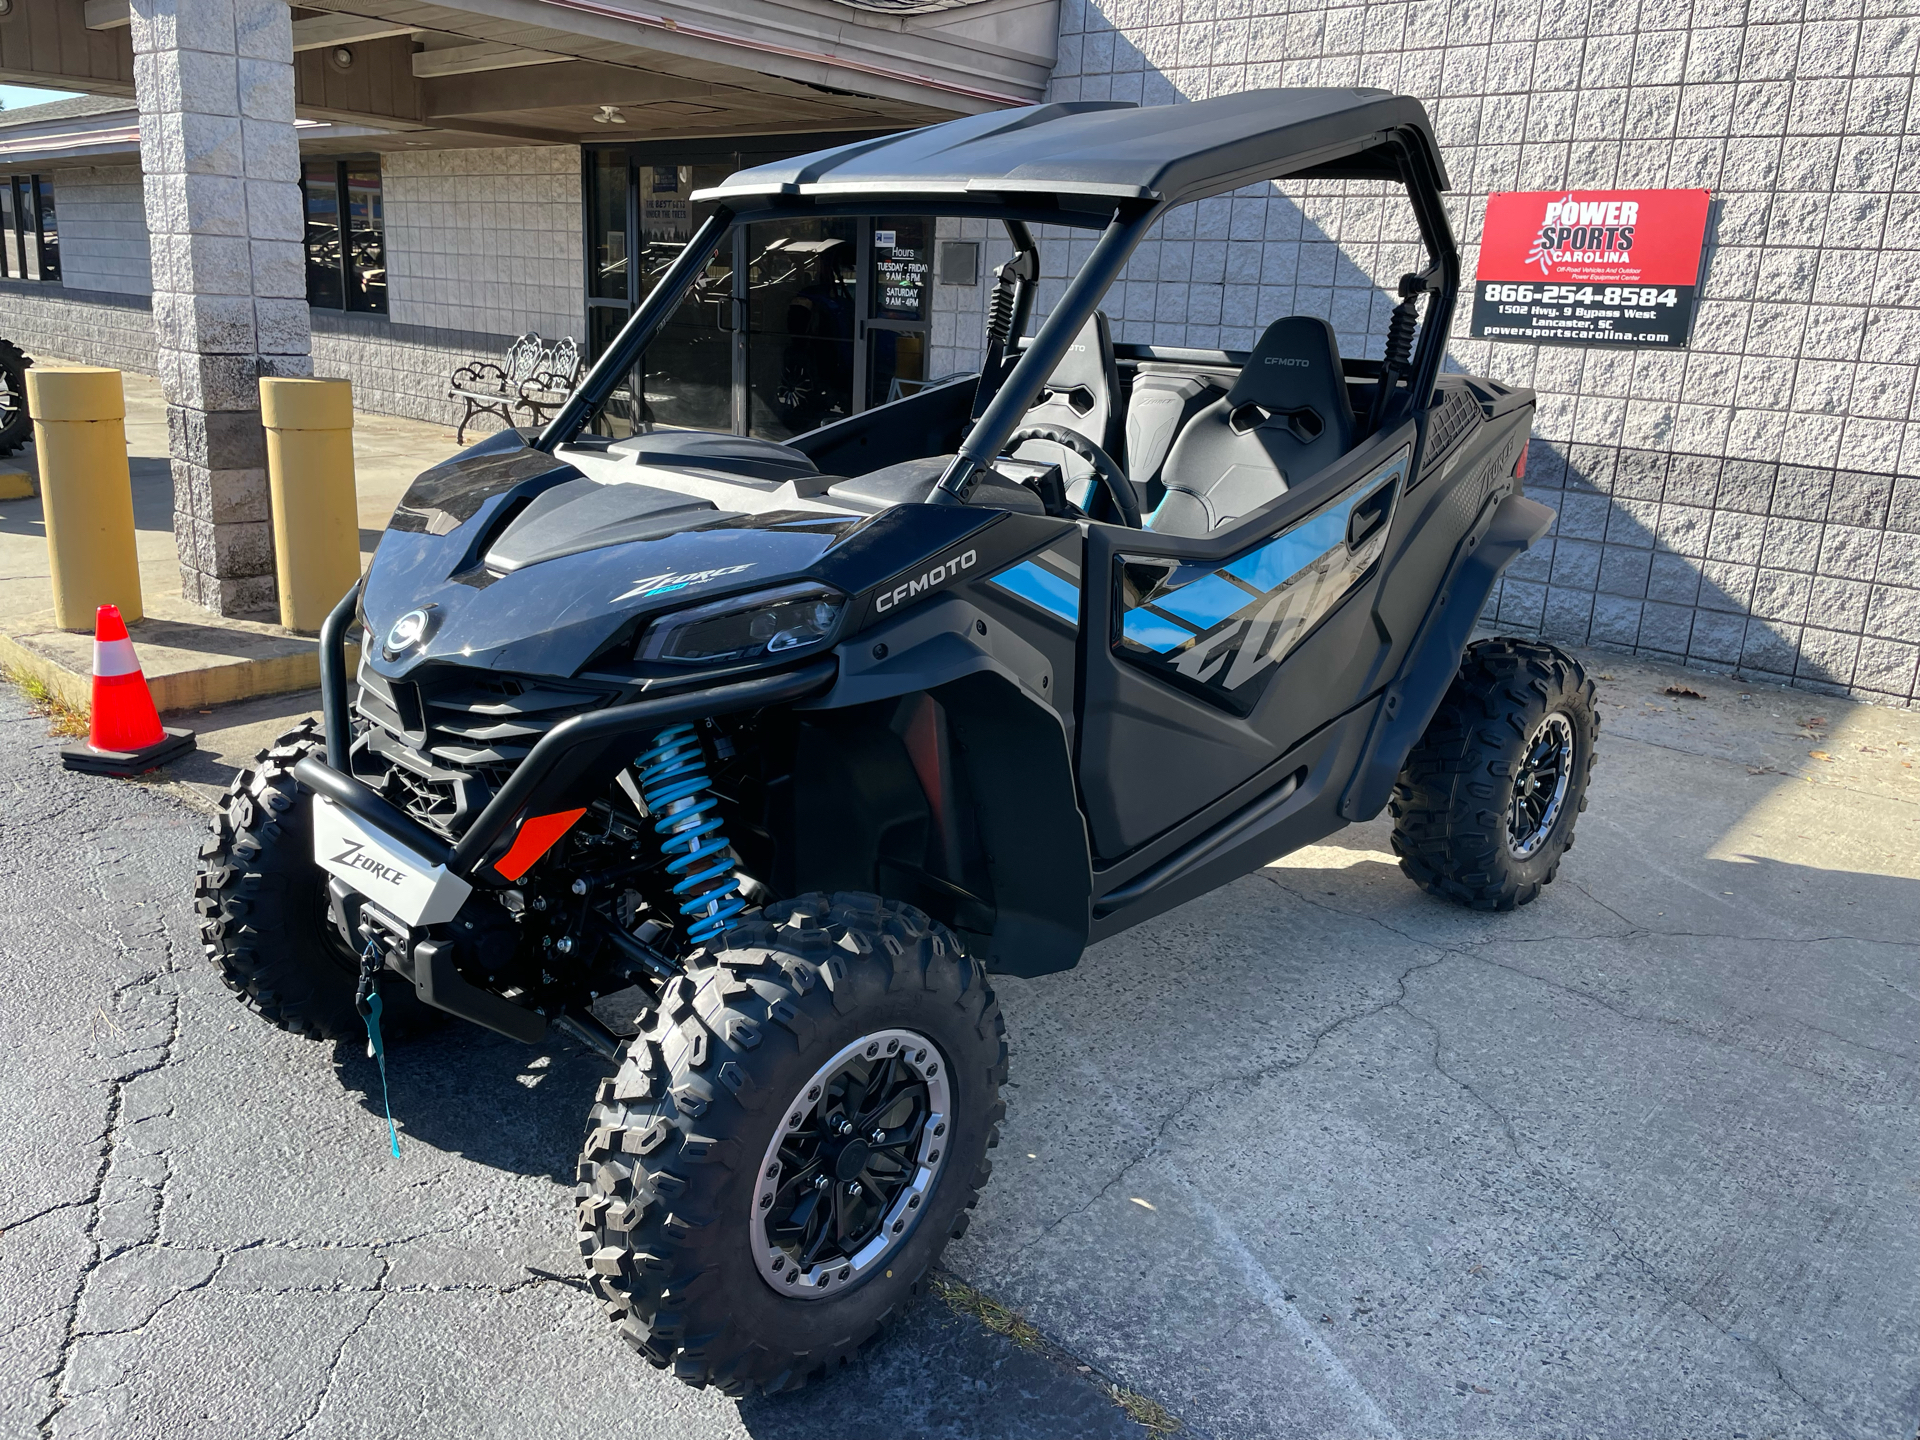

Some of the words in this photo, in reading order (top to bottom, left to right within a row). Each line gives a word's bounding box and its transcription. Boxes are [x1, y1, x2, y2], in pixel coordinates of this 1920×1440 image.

[655, 200, 672, 209] BEST
[1544, 201, 1639, 226] POWER
[1541, 226, 1634, 251] SPORTS
[892, 247, 914, 257] Hours
[1552, 251, 1630, 264] CAROLINA
[877, 262, 904, 271] TUESDAY
[886, 272, 890, 280] 9
[890, 272, 902, 281] AM
[905, 273, 910, 281] 6
[910, 273, 921, 282] PM
[886, 287, 918, 297] SATURDAY
[1485, 284, 1677, 308] 866-254-8584
[885, 297, 890, 305] 9
[890, 297, 902, 306] AM
[1499, 305, 1528, 315] 1502
[1531, 306, 1559, 318] Hwy.
[1563, 307, 1572, 316] 9
[1575, 307, 1620, 319] Bypass
[1624, 309, 1656, 320] West
[1532, 317, 1594, 330] Lancaster,
[1597, 320, 1613, 330] SC
[1484, 325, 1669, 343] powersportscarolina.com
[1067, 344, 1086, 352] OTO
[1264, 356, 1310, 368] CFMOTO
[875, 549, 977, 614] CFMOTO
[329, 837, 408, 886] ZFORCE
